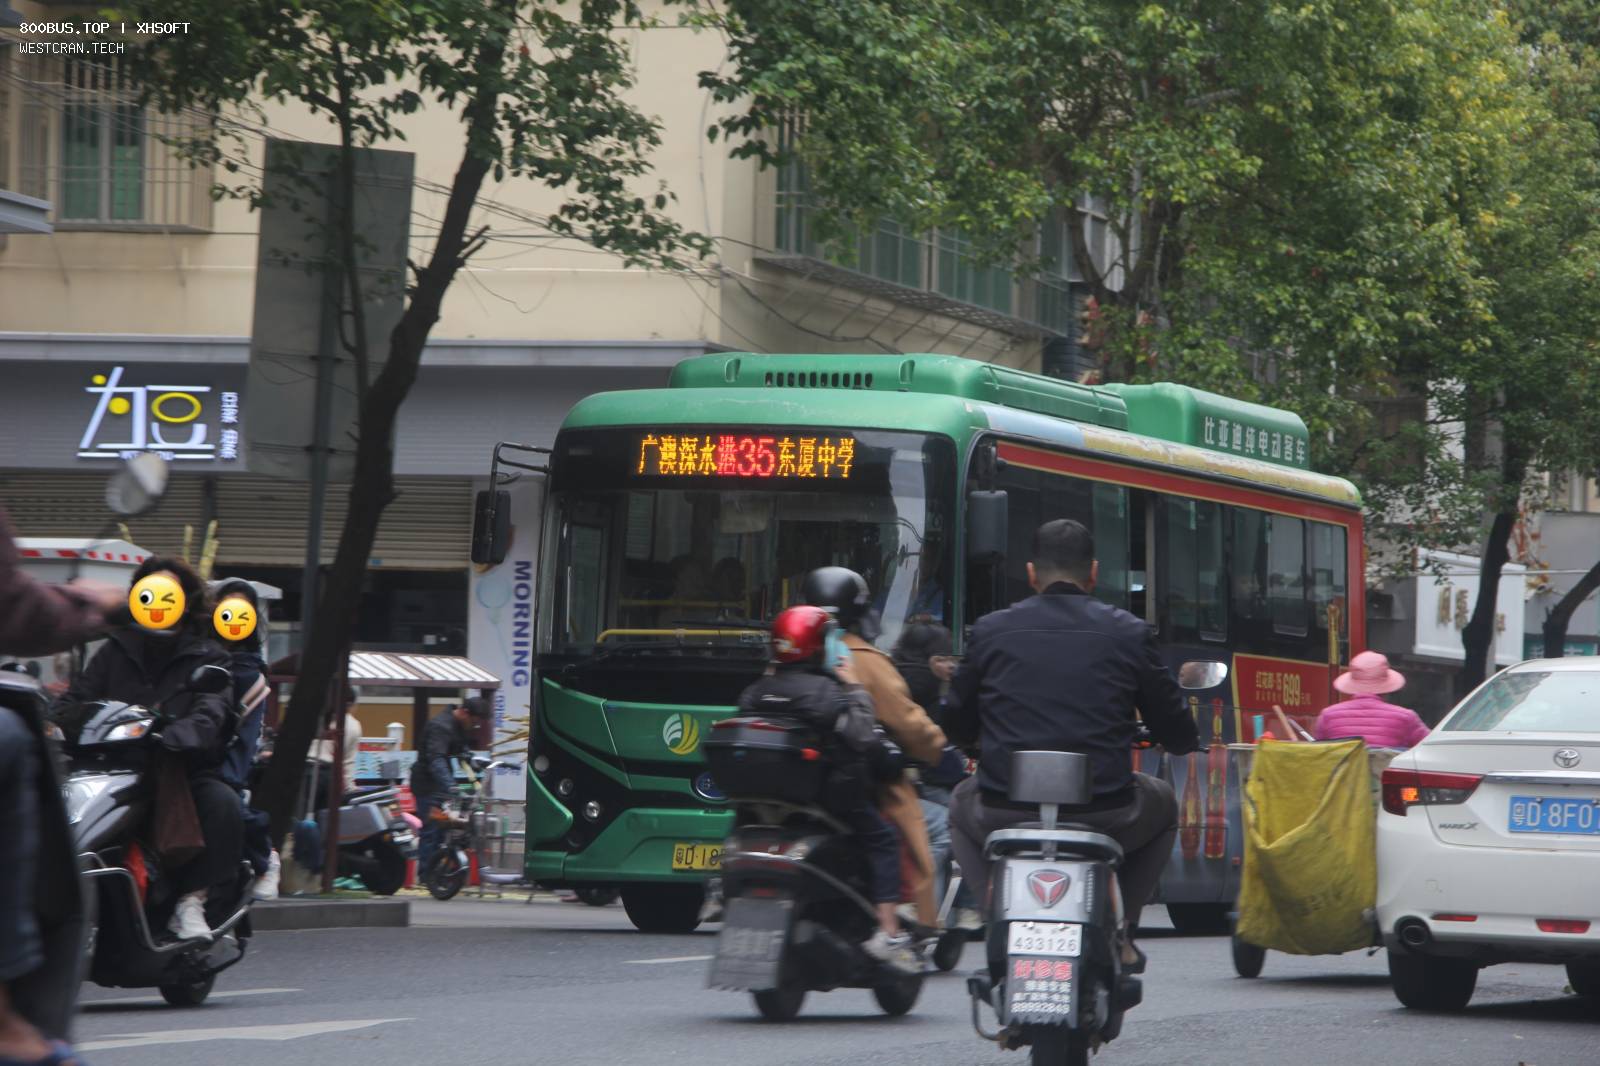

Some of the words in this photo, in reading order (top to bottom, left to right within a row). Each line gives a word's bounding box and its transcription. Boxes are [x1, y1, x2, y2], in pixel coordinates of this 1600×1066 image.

[1204, 416, 1305, 464] 比亚迪纯电动客车
[513, 560, 533, 688] MORNING
[1283, 673, 1301, 706] 699
[1512, 801, 1600, 828] 粤D·8F0
[1014, 936, 1078, 952] 433126
